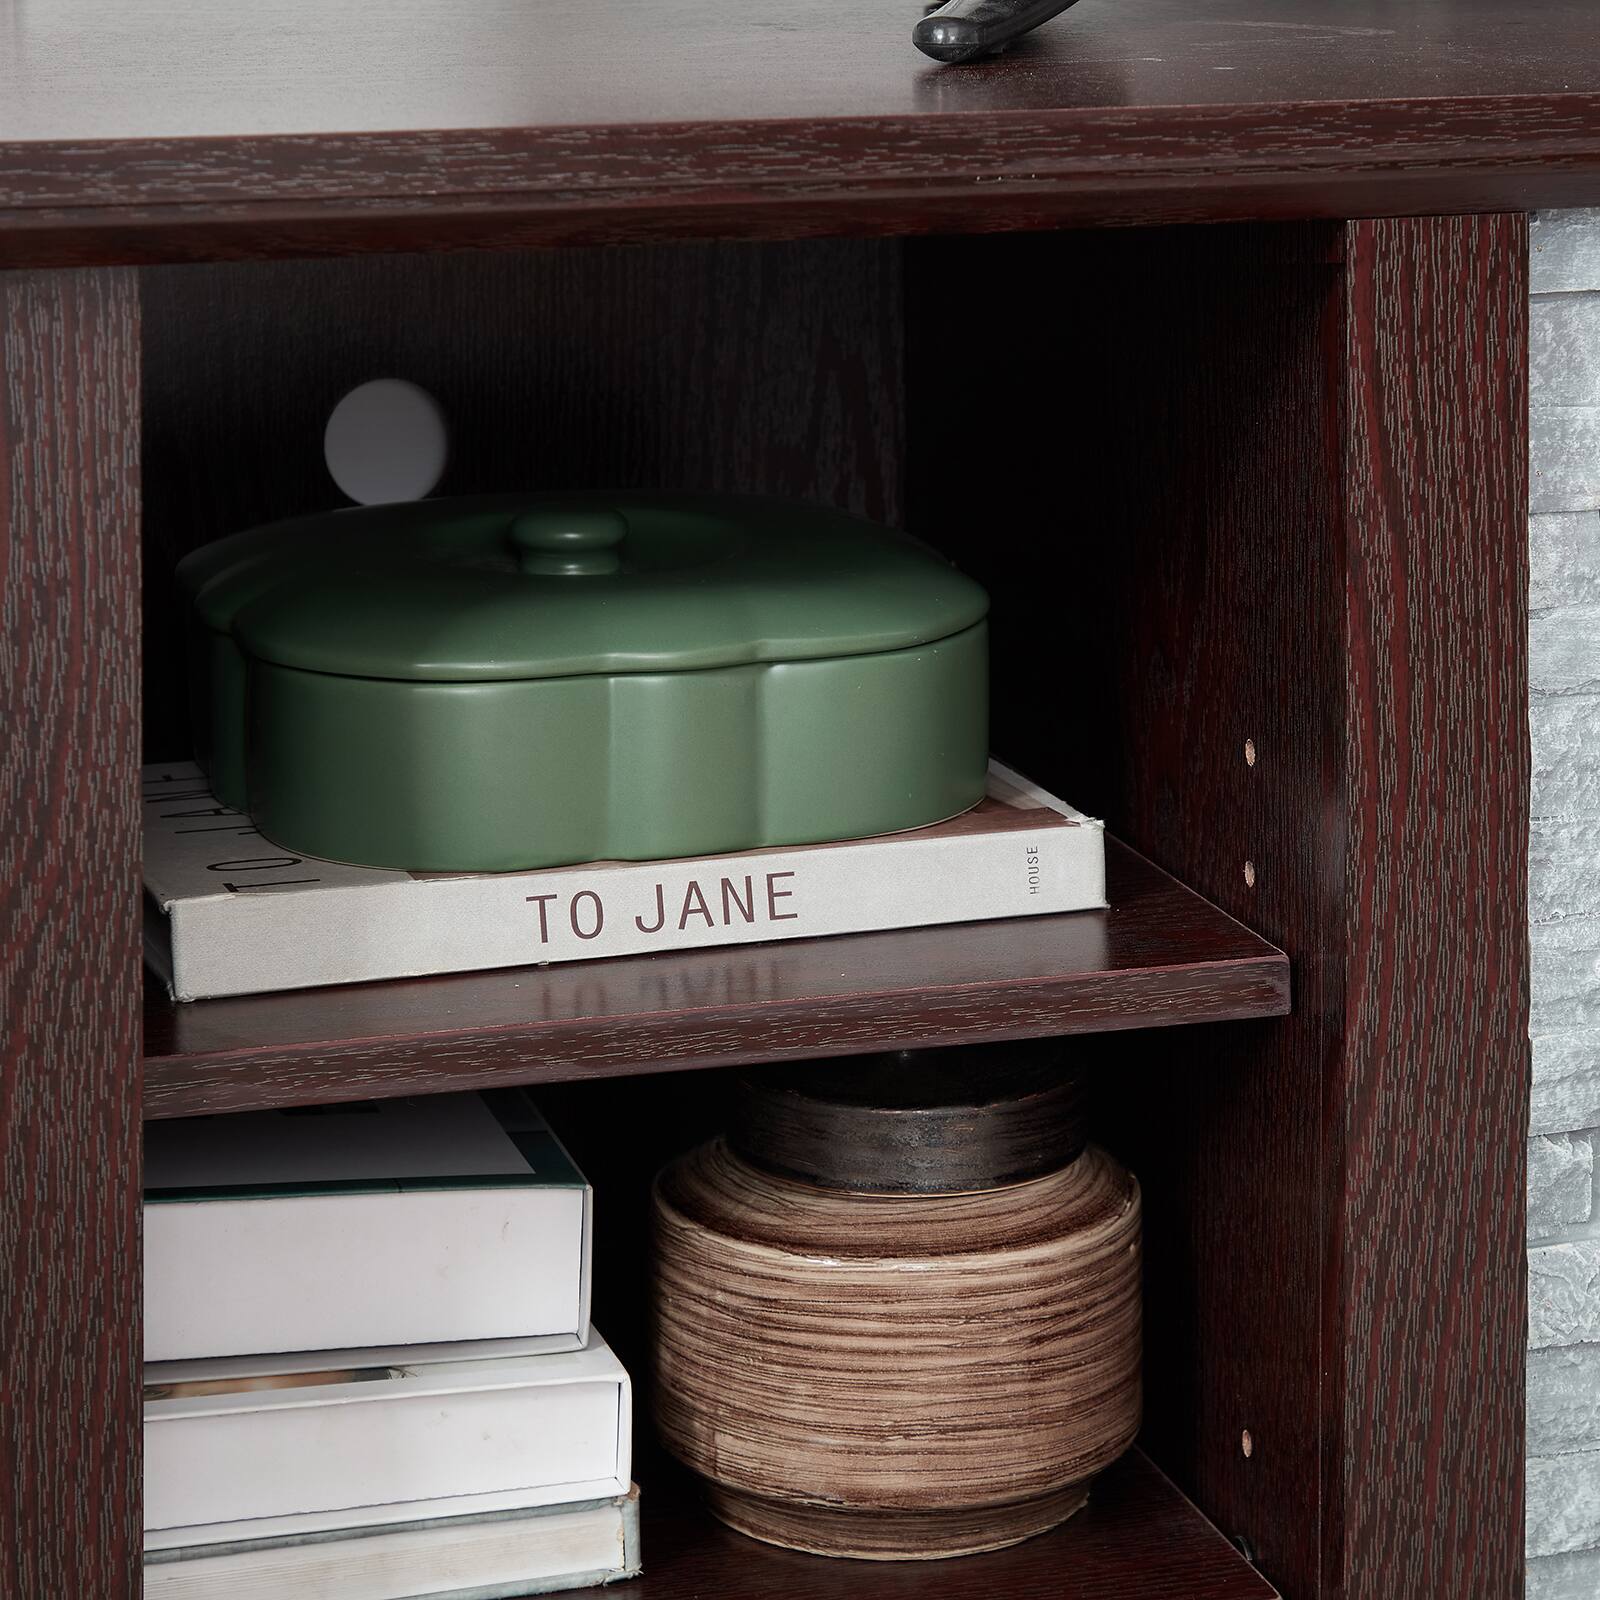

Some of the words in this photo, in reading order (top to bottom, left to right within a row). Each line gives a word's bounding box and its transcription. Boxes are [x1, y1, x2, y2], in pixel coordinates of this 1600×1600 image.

[206, 857, 321, 892] TO
[1026, 846, 1040, 895] HOUSE
[526, 891, 604, 943] TO
[635, 871, 798, 933] JANE
